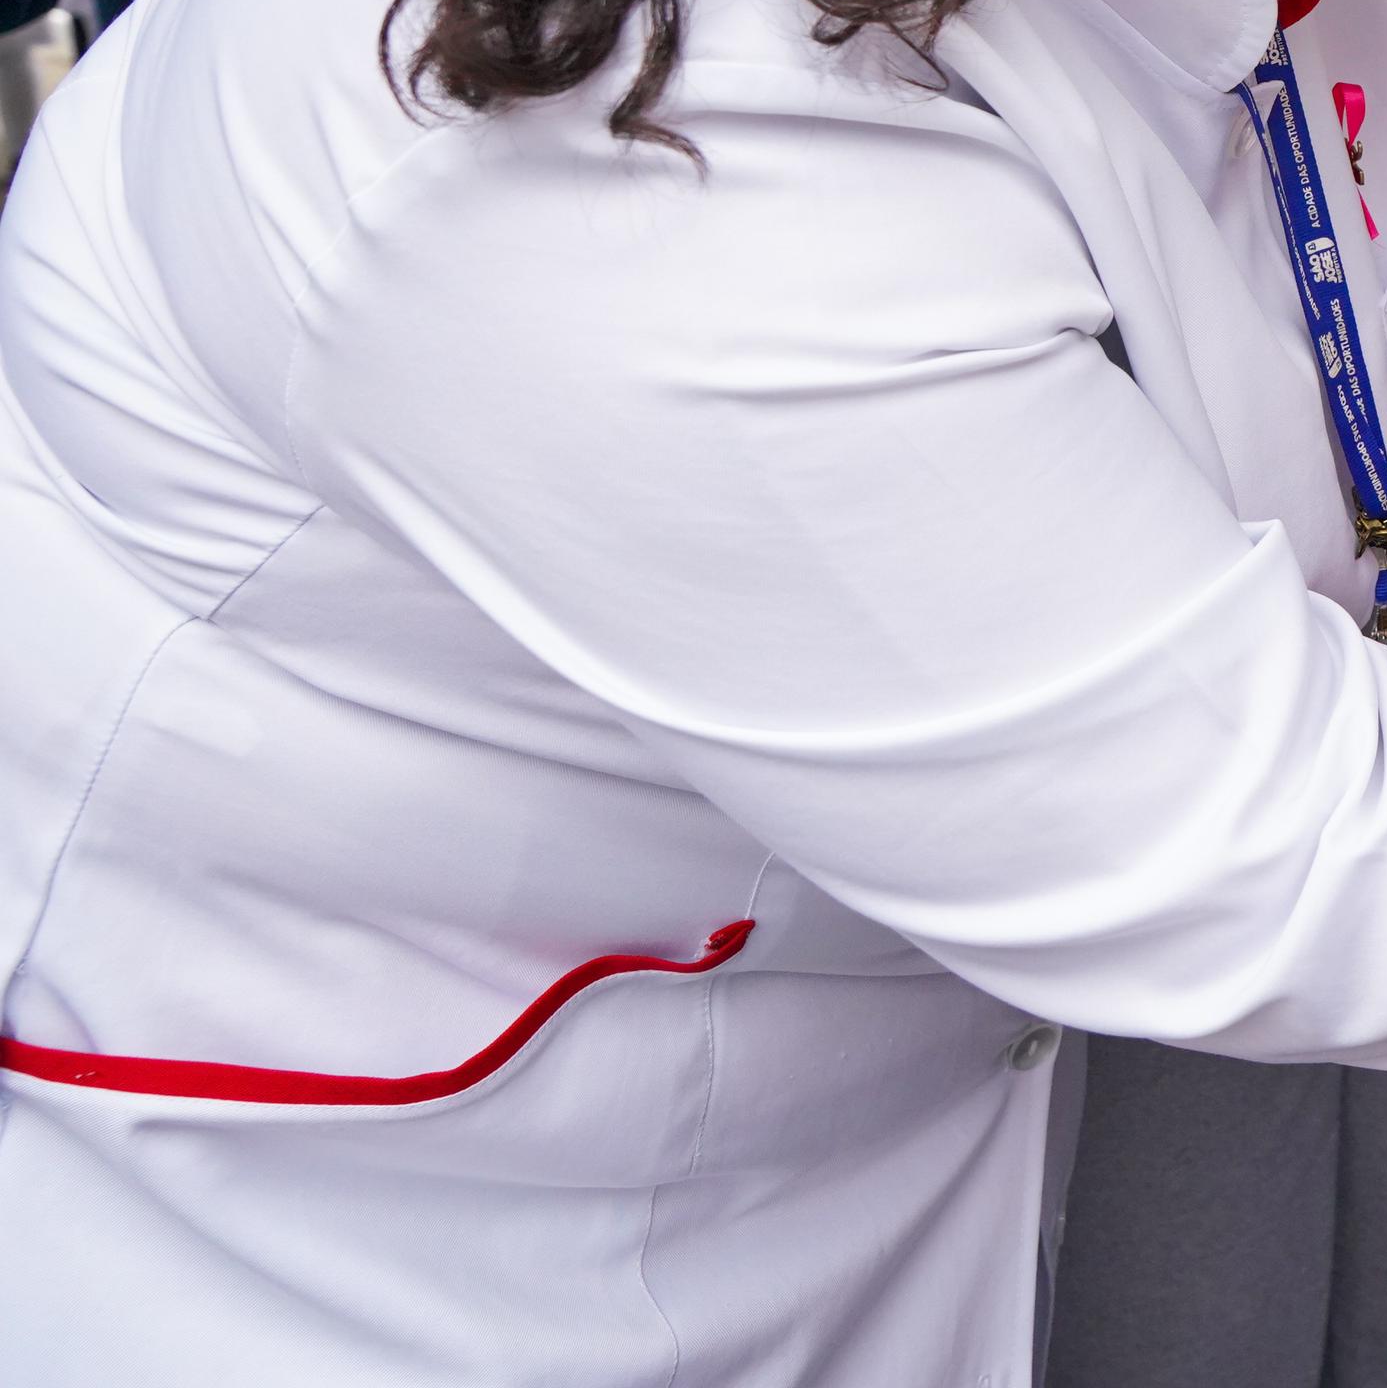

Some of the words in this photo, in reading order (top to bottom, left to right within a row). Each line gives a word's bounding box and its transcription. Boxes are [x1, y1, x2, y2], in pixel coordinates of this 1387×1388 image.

[1279, 86, 1305, 164] OPORTUNIDADE
[1297, 164, 1311, 185] DAS
[1303, 186, 1319, 220] CIDADE
[1330, 298, 1356, 376] OPORTUNIDADES
[1349, 376, 1362, 396] DAS
[1338, 392, 1355, 423] CIDADE
[1351, 423, 1362, 442] DAS
